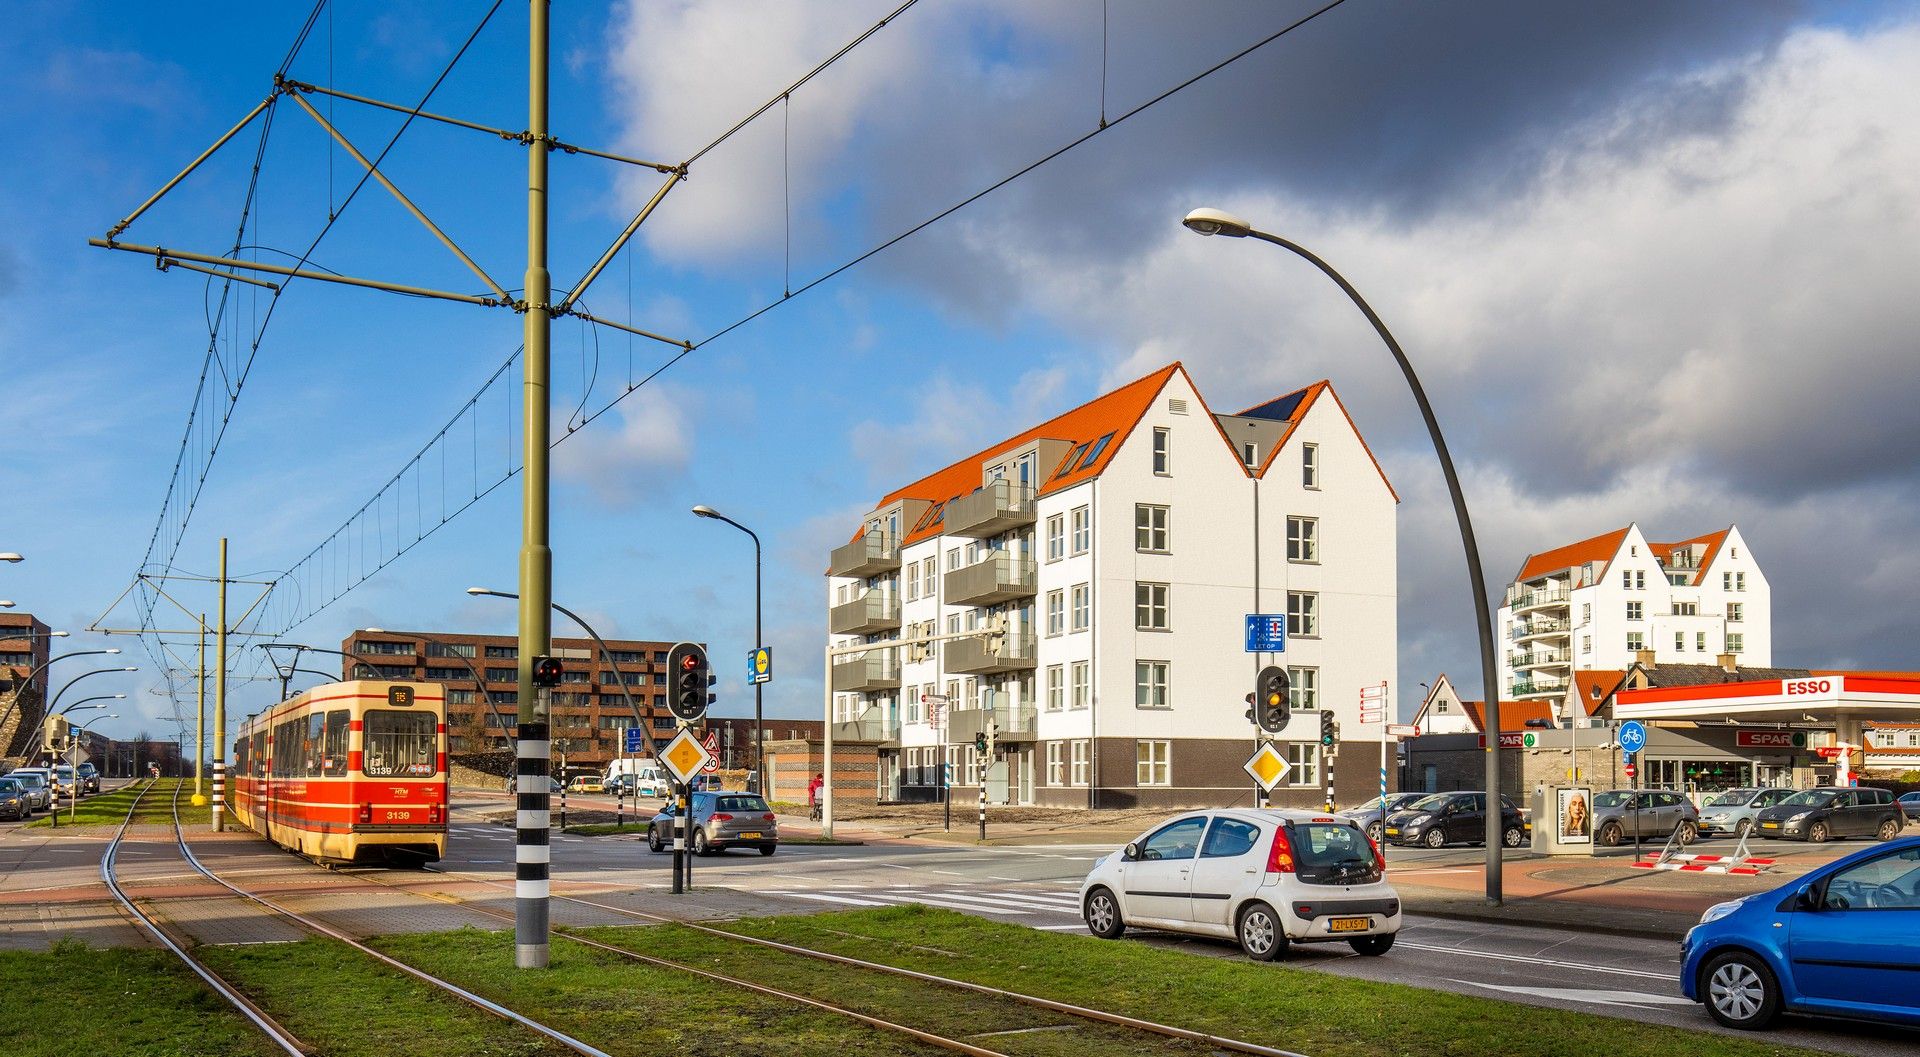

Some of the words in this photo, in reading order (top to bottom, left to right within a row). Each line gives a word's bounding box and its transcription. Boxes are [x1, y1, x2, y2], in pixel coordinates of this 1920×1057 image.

[1787, 680, 1831, 695] ESSO
[1750, 734, 1791, 744] SPAR
[370, 767, 392, 775] 3139
[386, 811, 410, 820] 3139
[1335, 919, 1364, 930] 21-LXS-7
